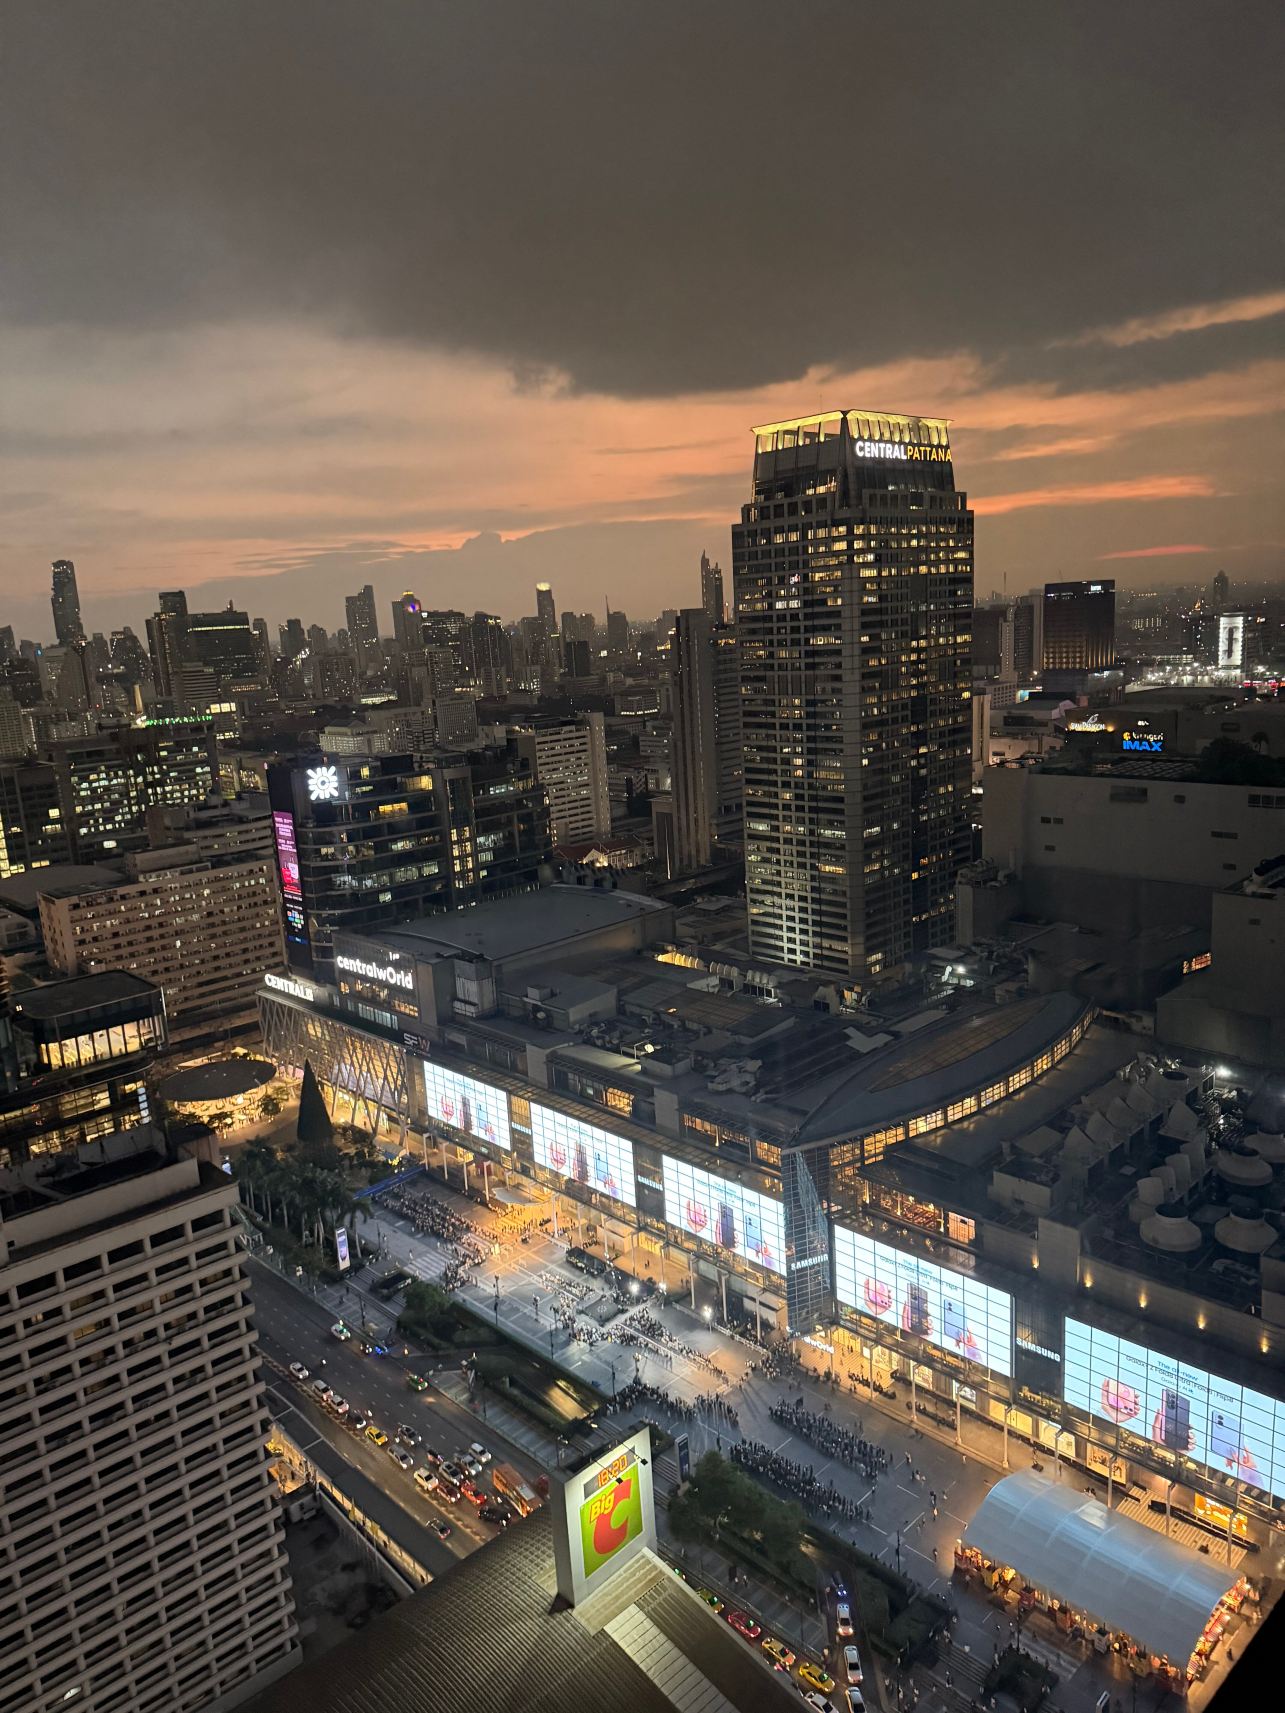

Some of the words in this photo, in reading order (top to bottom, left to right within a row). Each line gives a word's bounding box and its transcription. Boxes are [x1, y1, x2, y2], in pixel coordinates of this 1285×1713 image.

[1123, 740, 1162, 752] IMAX
[336, 955, 414, 989] centralwOrld
[790, 1253, 829, 1270] SAMSUNG
[1016, 1337, 1061, 1362] SAMSUNG
[1171, 1367, 1199, 1381] a-new
[589, 1492, 615, 1523] Big
[593, 1477, 634, 1555] C
